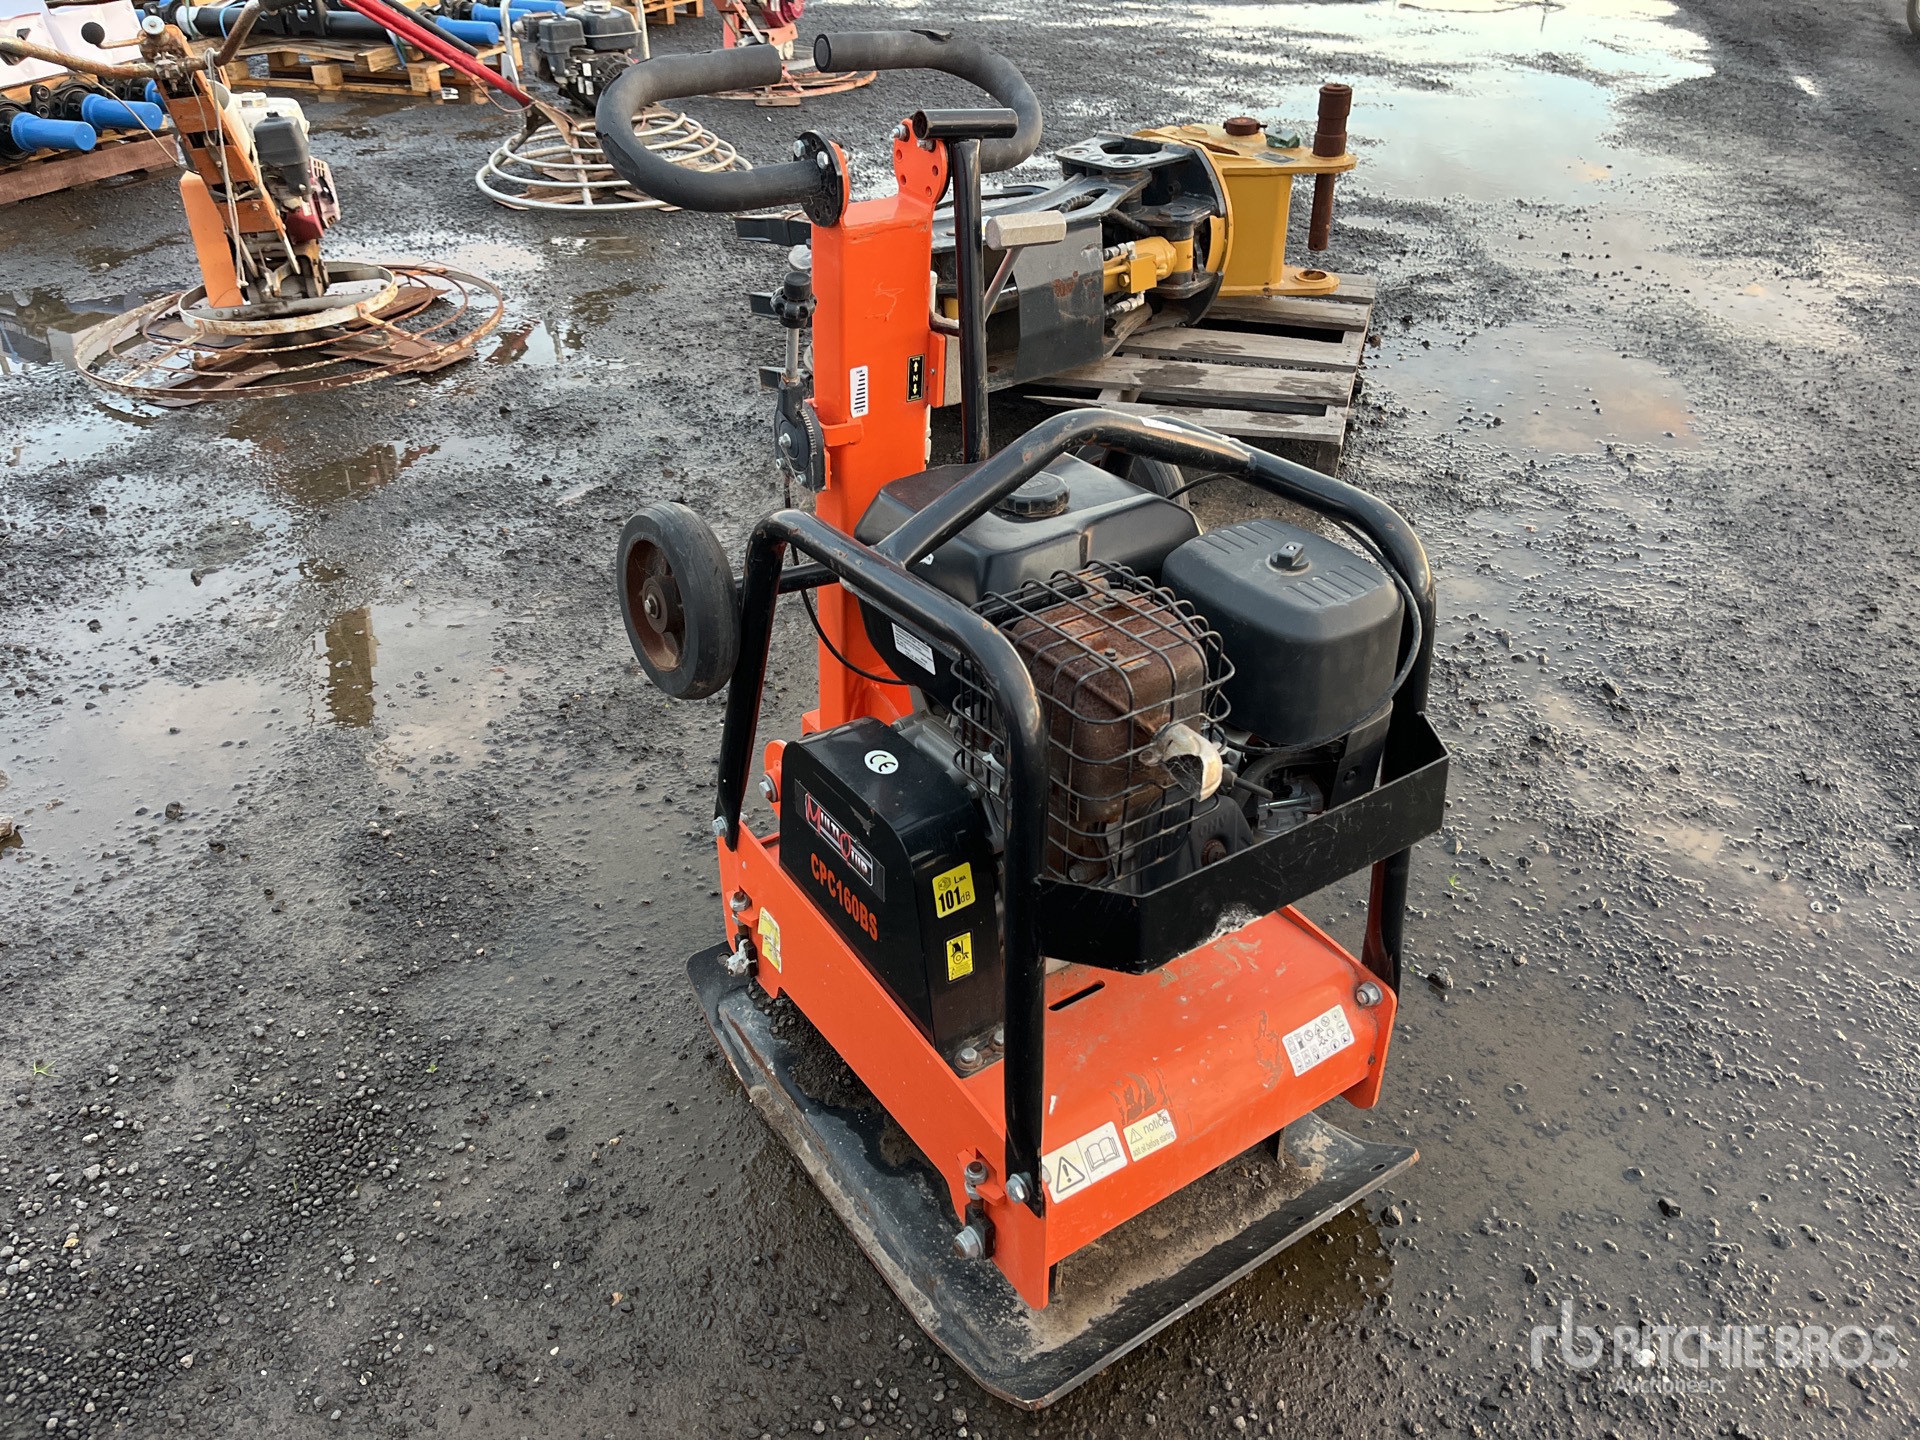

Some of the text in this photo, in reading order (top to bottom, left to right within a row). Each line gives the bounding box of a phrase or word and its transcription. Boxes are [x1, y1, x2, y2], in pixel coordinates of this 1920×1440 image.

[810, 852, 879, 941] CPC160BS
[938, 886, 971, 912] 101 dB
[1143, 1115, 1169, 1134] notice
